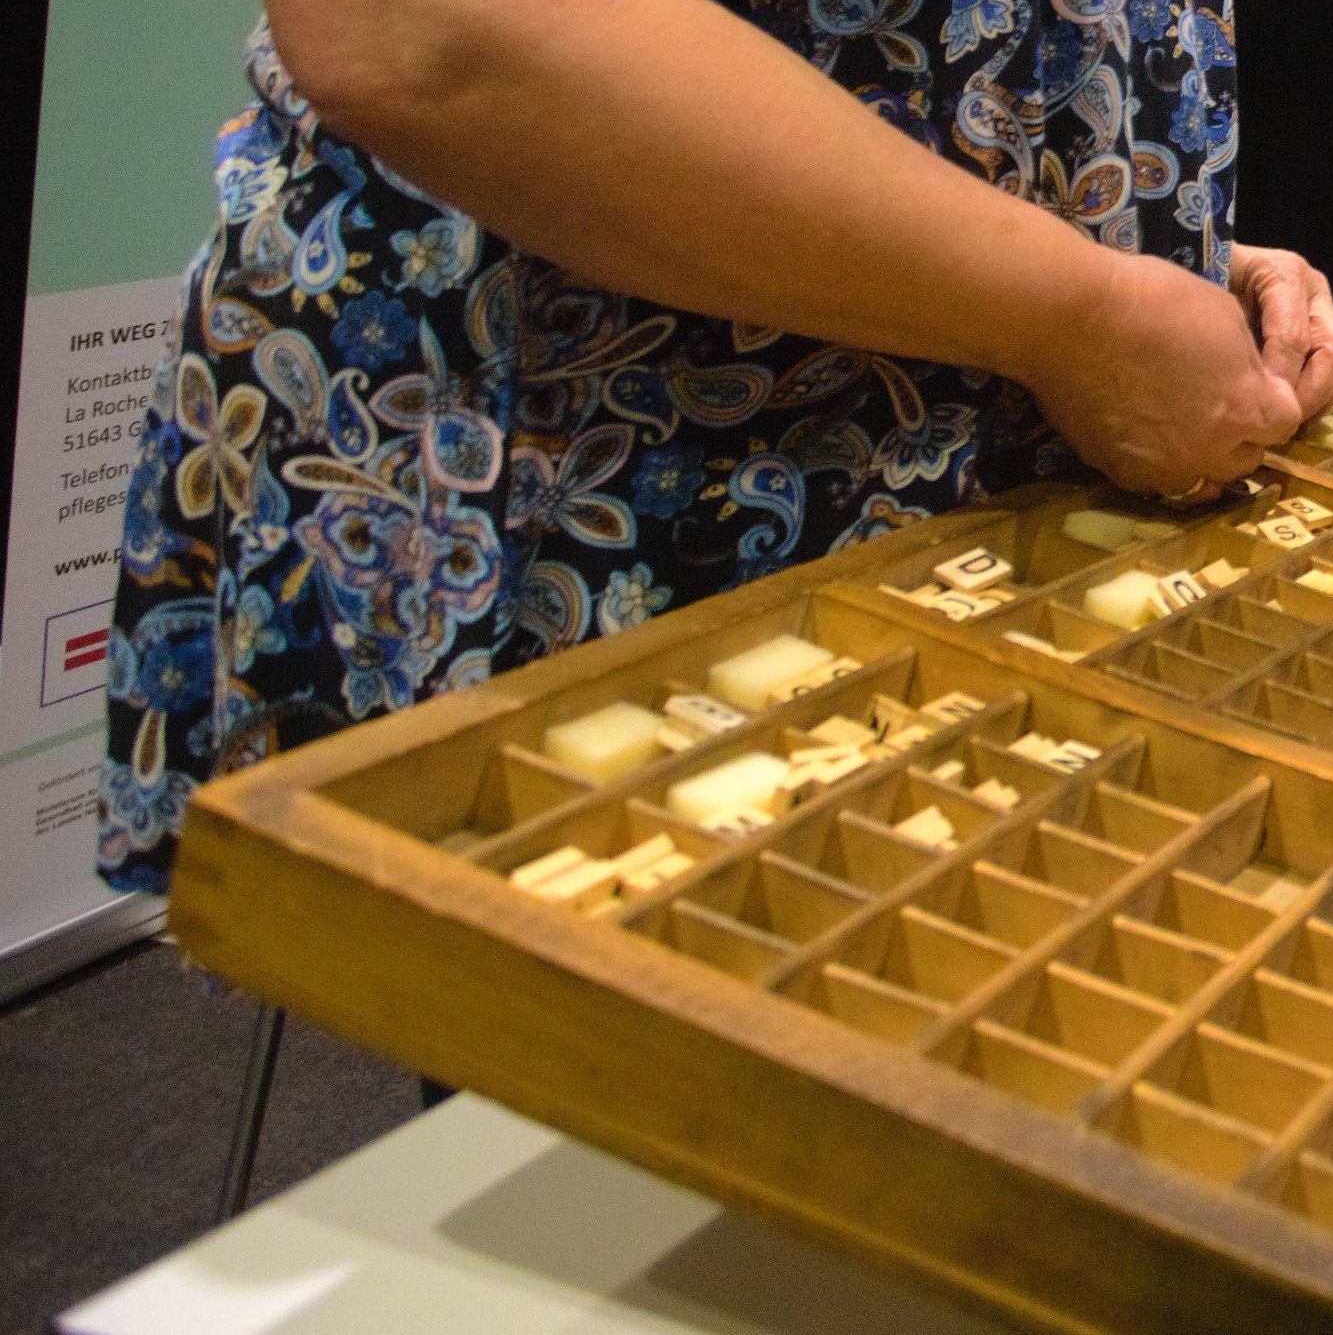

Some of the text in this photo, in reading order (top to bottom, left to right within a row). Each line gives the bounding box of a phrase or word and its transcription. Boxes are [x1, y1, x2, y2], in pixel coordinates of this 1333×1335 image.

[70, 330, 104, 353] IHR
[110, 322, 156, 345] WEG
[67, 366, 152, 395] Kontaktb
[65, 394, 149, 424] La Roche
[63, 424, 122, 453] 51643
[57, 490, 127, 523] pfleges
